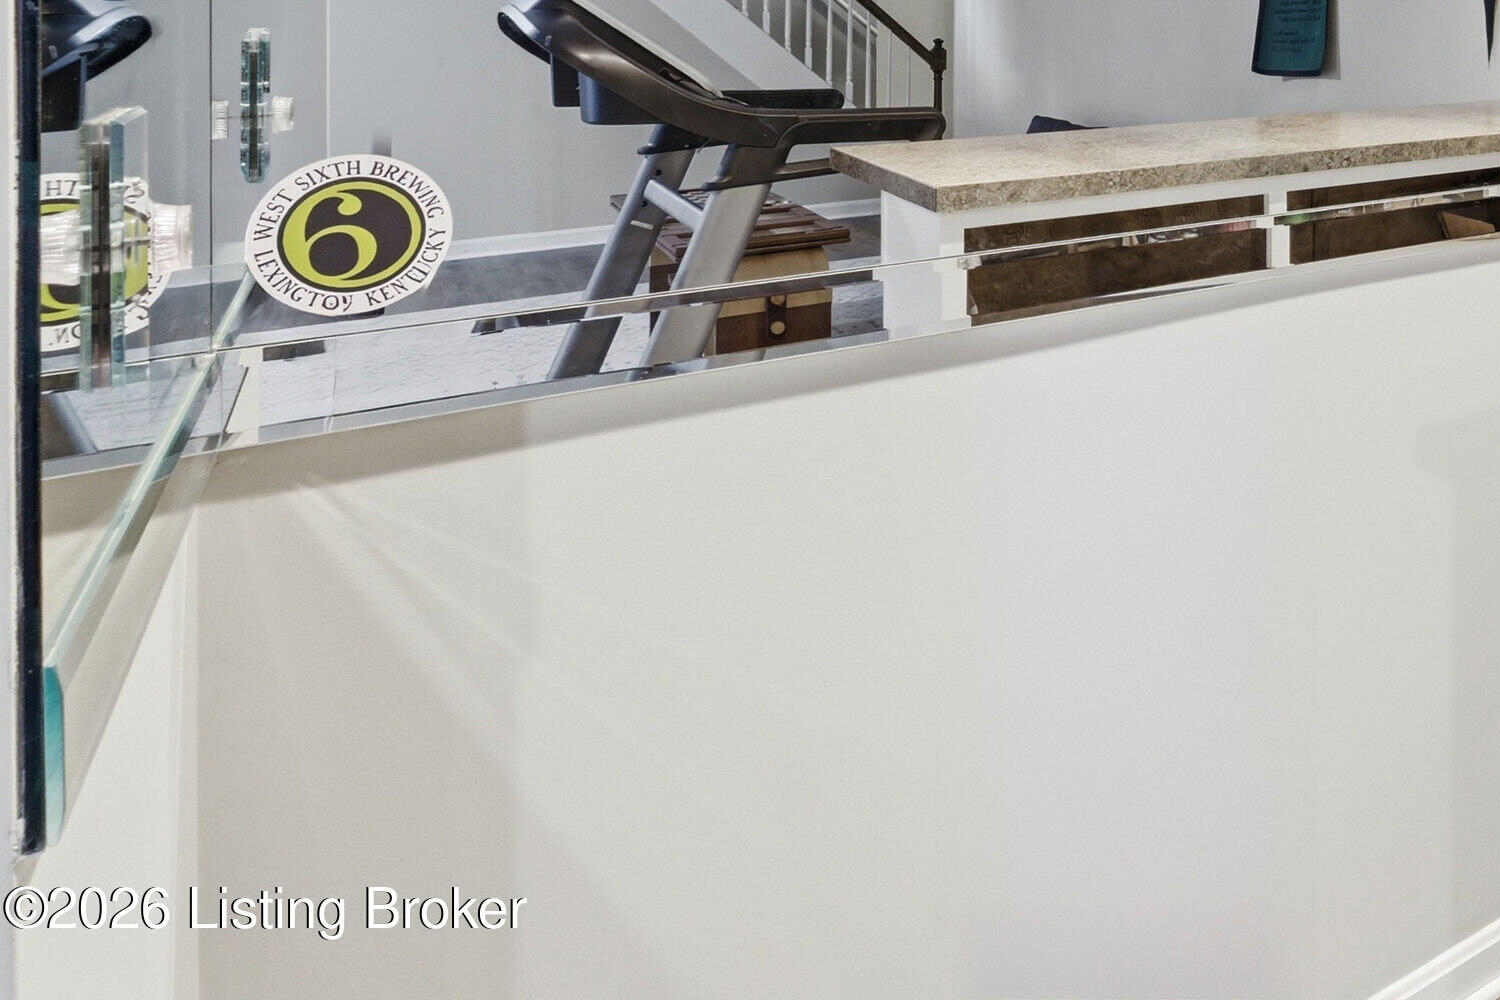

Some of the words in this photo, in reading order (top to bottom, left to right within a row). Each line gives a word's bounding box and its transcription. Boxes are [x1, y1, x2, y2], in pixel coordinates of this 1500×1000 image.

[253, 189, 292, 242] WEST
[295, 160, 361, 191] SIXTH
[369, 161, 444, 219] BREWING
[366, 228, 446, 306] KENTUCKY
